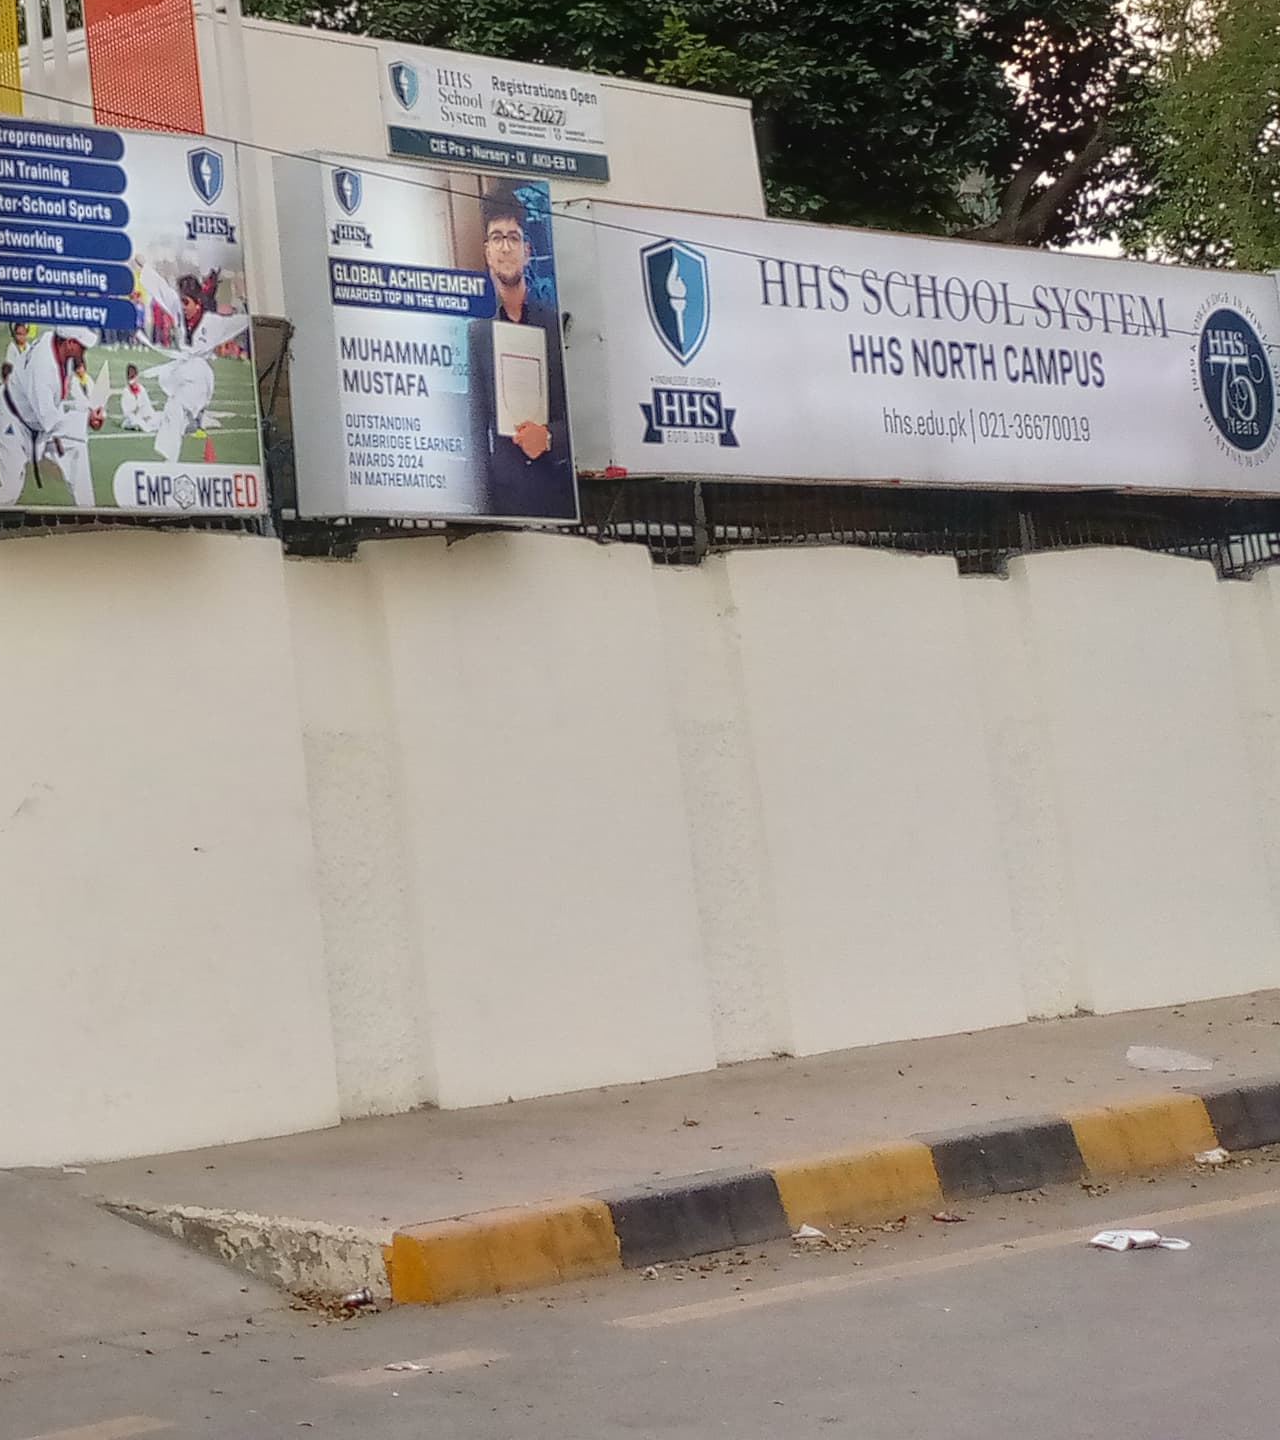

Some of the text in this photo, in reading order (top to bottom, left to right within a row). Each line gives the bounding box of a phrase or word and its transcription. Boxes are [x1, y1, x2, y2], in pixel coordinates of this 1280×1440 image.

[437, 68, 473, 89] HHS
[491, 75, 598, 106] Registrations Open
[439, 87, 483, 109] School
[441, 105, 487, 128] System
[429, 138, 448, 155] CIE
[17, 161, 70, 186] Training
[68, 200, 112, 221] Sports
[36, 264, 107, 291] Counseling
[333, 264, 486, 296] GLOBAL ACHIEVEMENT
[334, 287, 469, 310] AWARDED TOP IN THE WORLD
[757, 259, 849, 312] HHS
[861, 268, 1025, 327] SCHOOL
[1033, 284, 1170, 338] SYSTEM
[54, 301, 107, 325] Literacy
[340, 336, 453, 368] MUHAMMAD
[1206, 329, 1244, 355] HHS
[849, 333, 1106, 389] HHS NORTH CAMPUS
[342, 369, 429, 398] MUSTAFA
[659, 391, 719, 426] HHS
[345, 413, 421, 431] OUTSTANDING
[883, 407, 967, 443] hhs.edu.pk
[979, 411, 1091, 442] 021-36670019
[346, 433, 463, 452] CAMBRIDGE LEARNER
[348, 452, 424, 469] AWARDS 2024
[350, 471, 447, 489] IN MATHEMATICS!
